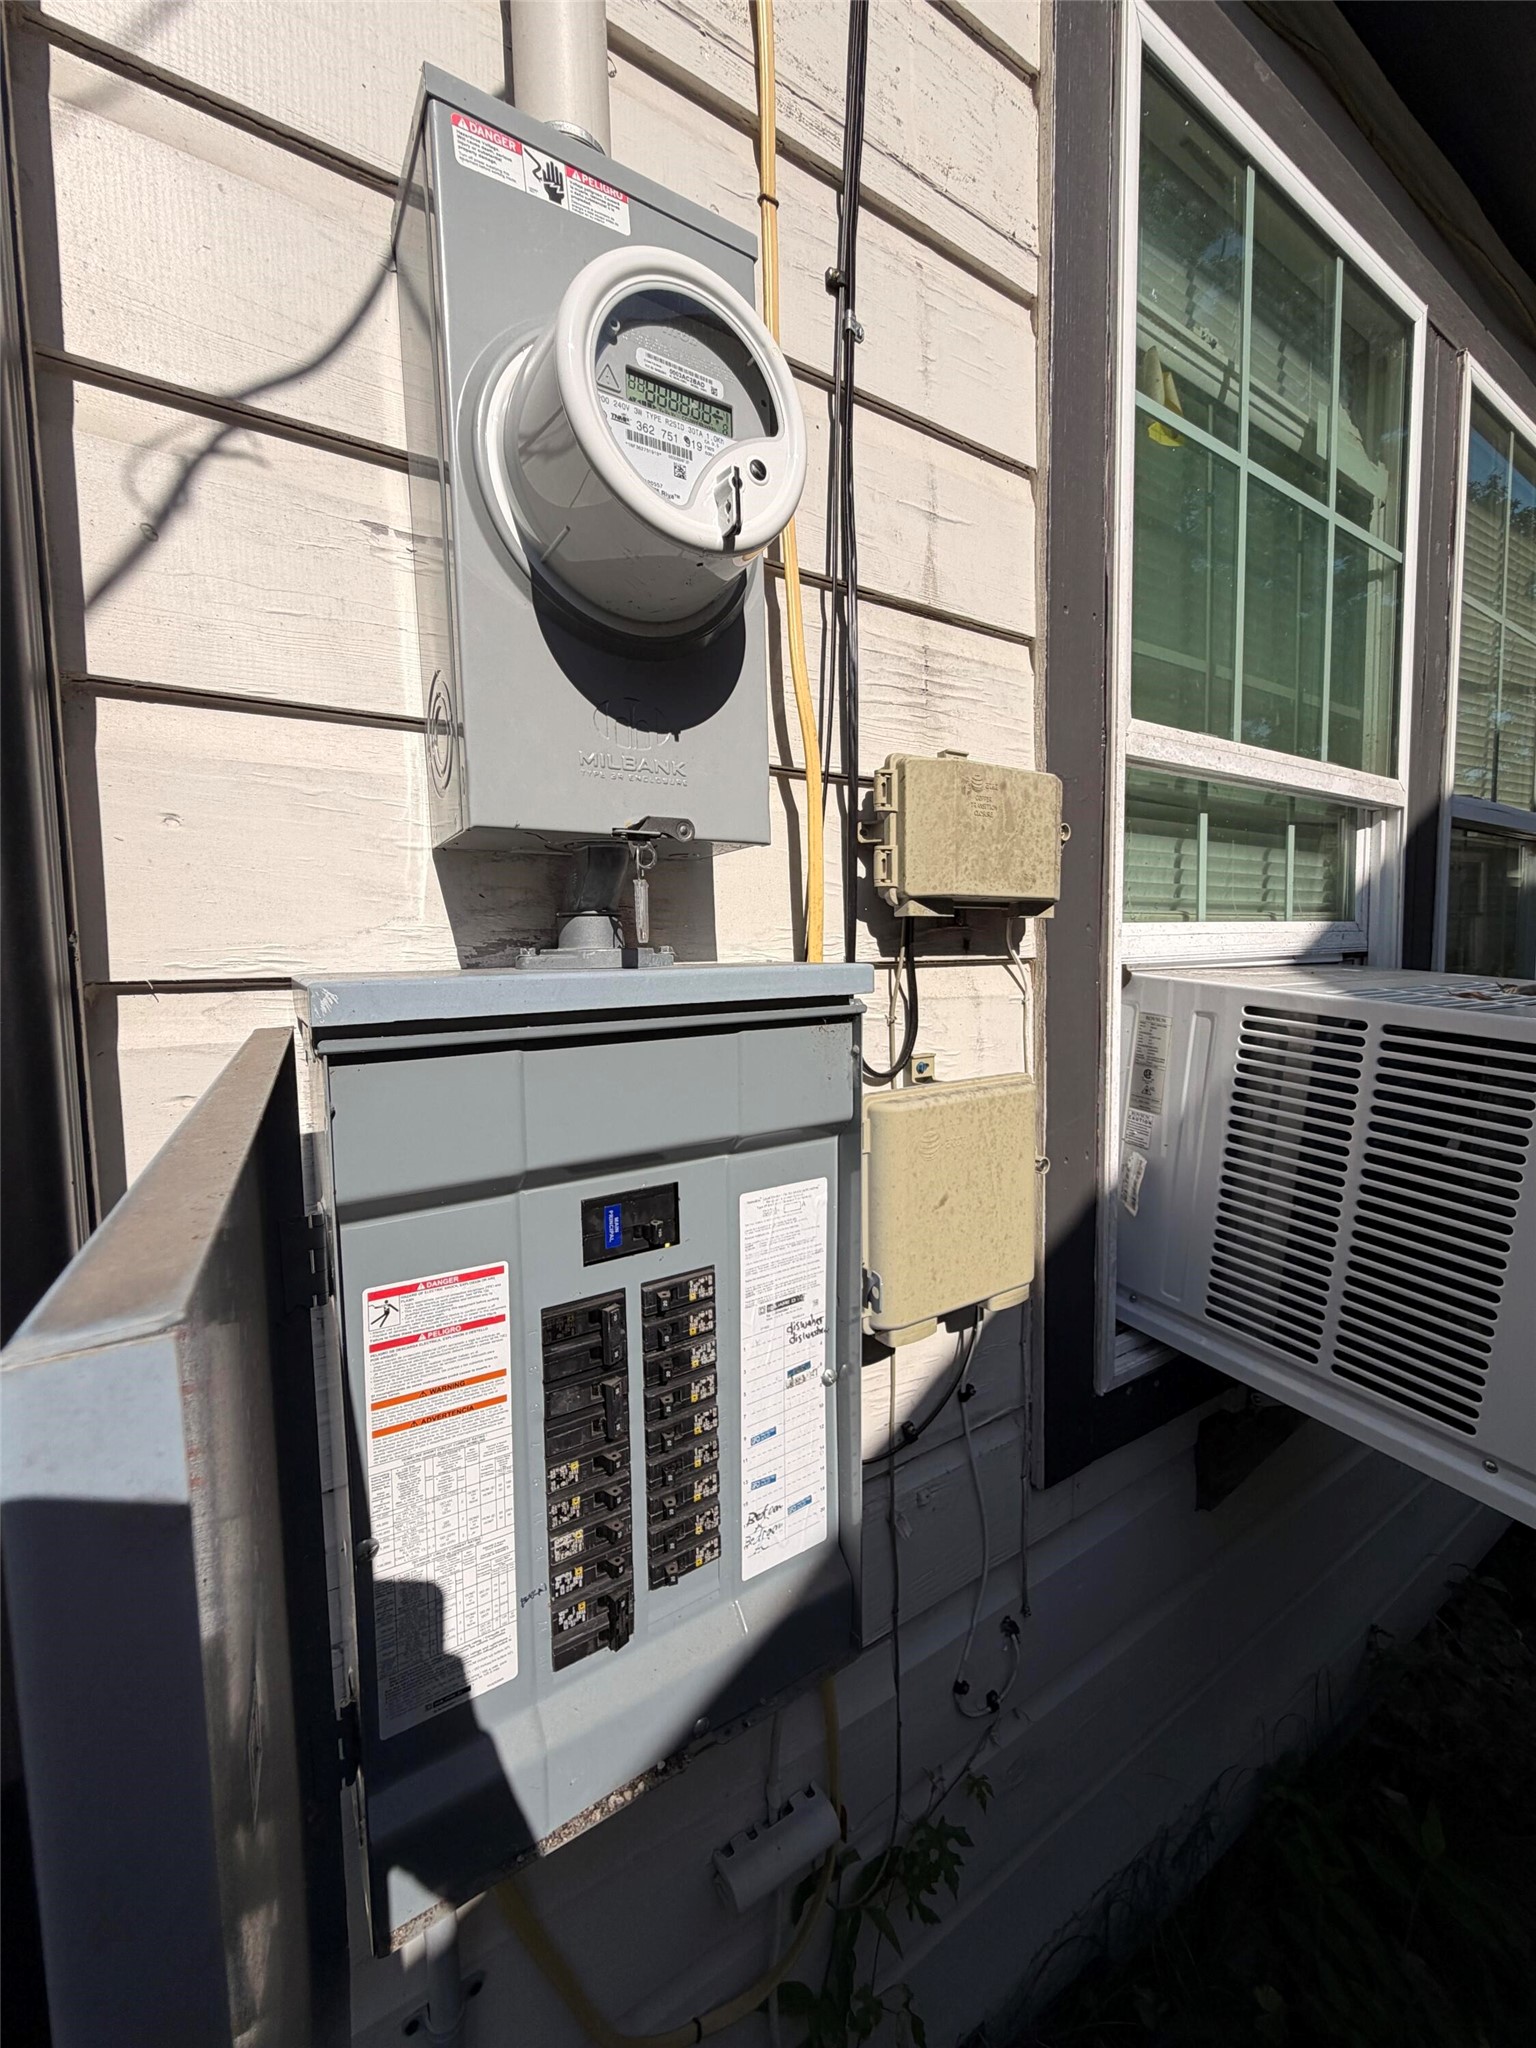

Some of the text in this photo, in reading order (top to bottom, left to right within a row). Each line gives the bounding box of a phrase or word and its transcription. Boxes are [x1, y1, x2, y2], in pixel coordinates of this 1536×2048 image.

[469, 121, 516, 151] DANGER
[613, 400, 629, 412] 240V
[646, 411, 662, 423] TYPE
[637, 421, 655, 436] 362
[661, 429, 677, 443] 751
[684, 435, 702, 451] 919
[579, 750, 687, 778] MILBANK
[1128, 1114, 1152, 1125] CAUTION
[426, 1275, 459, 1288] DANGER
[427, 1325, 461, 1338] PELIGRO
[429, 1380, 465, 1394] WARNING
[421, 1405, 474, 1424] ADVERTENCIA
